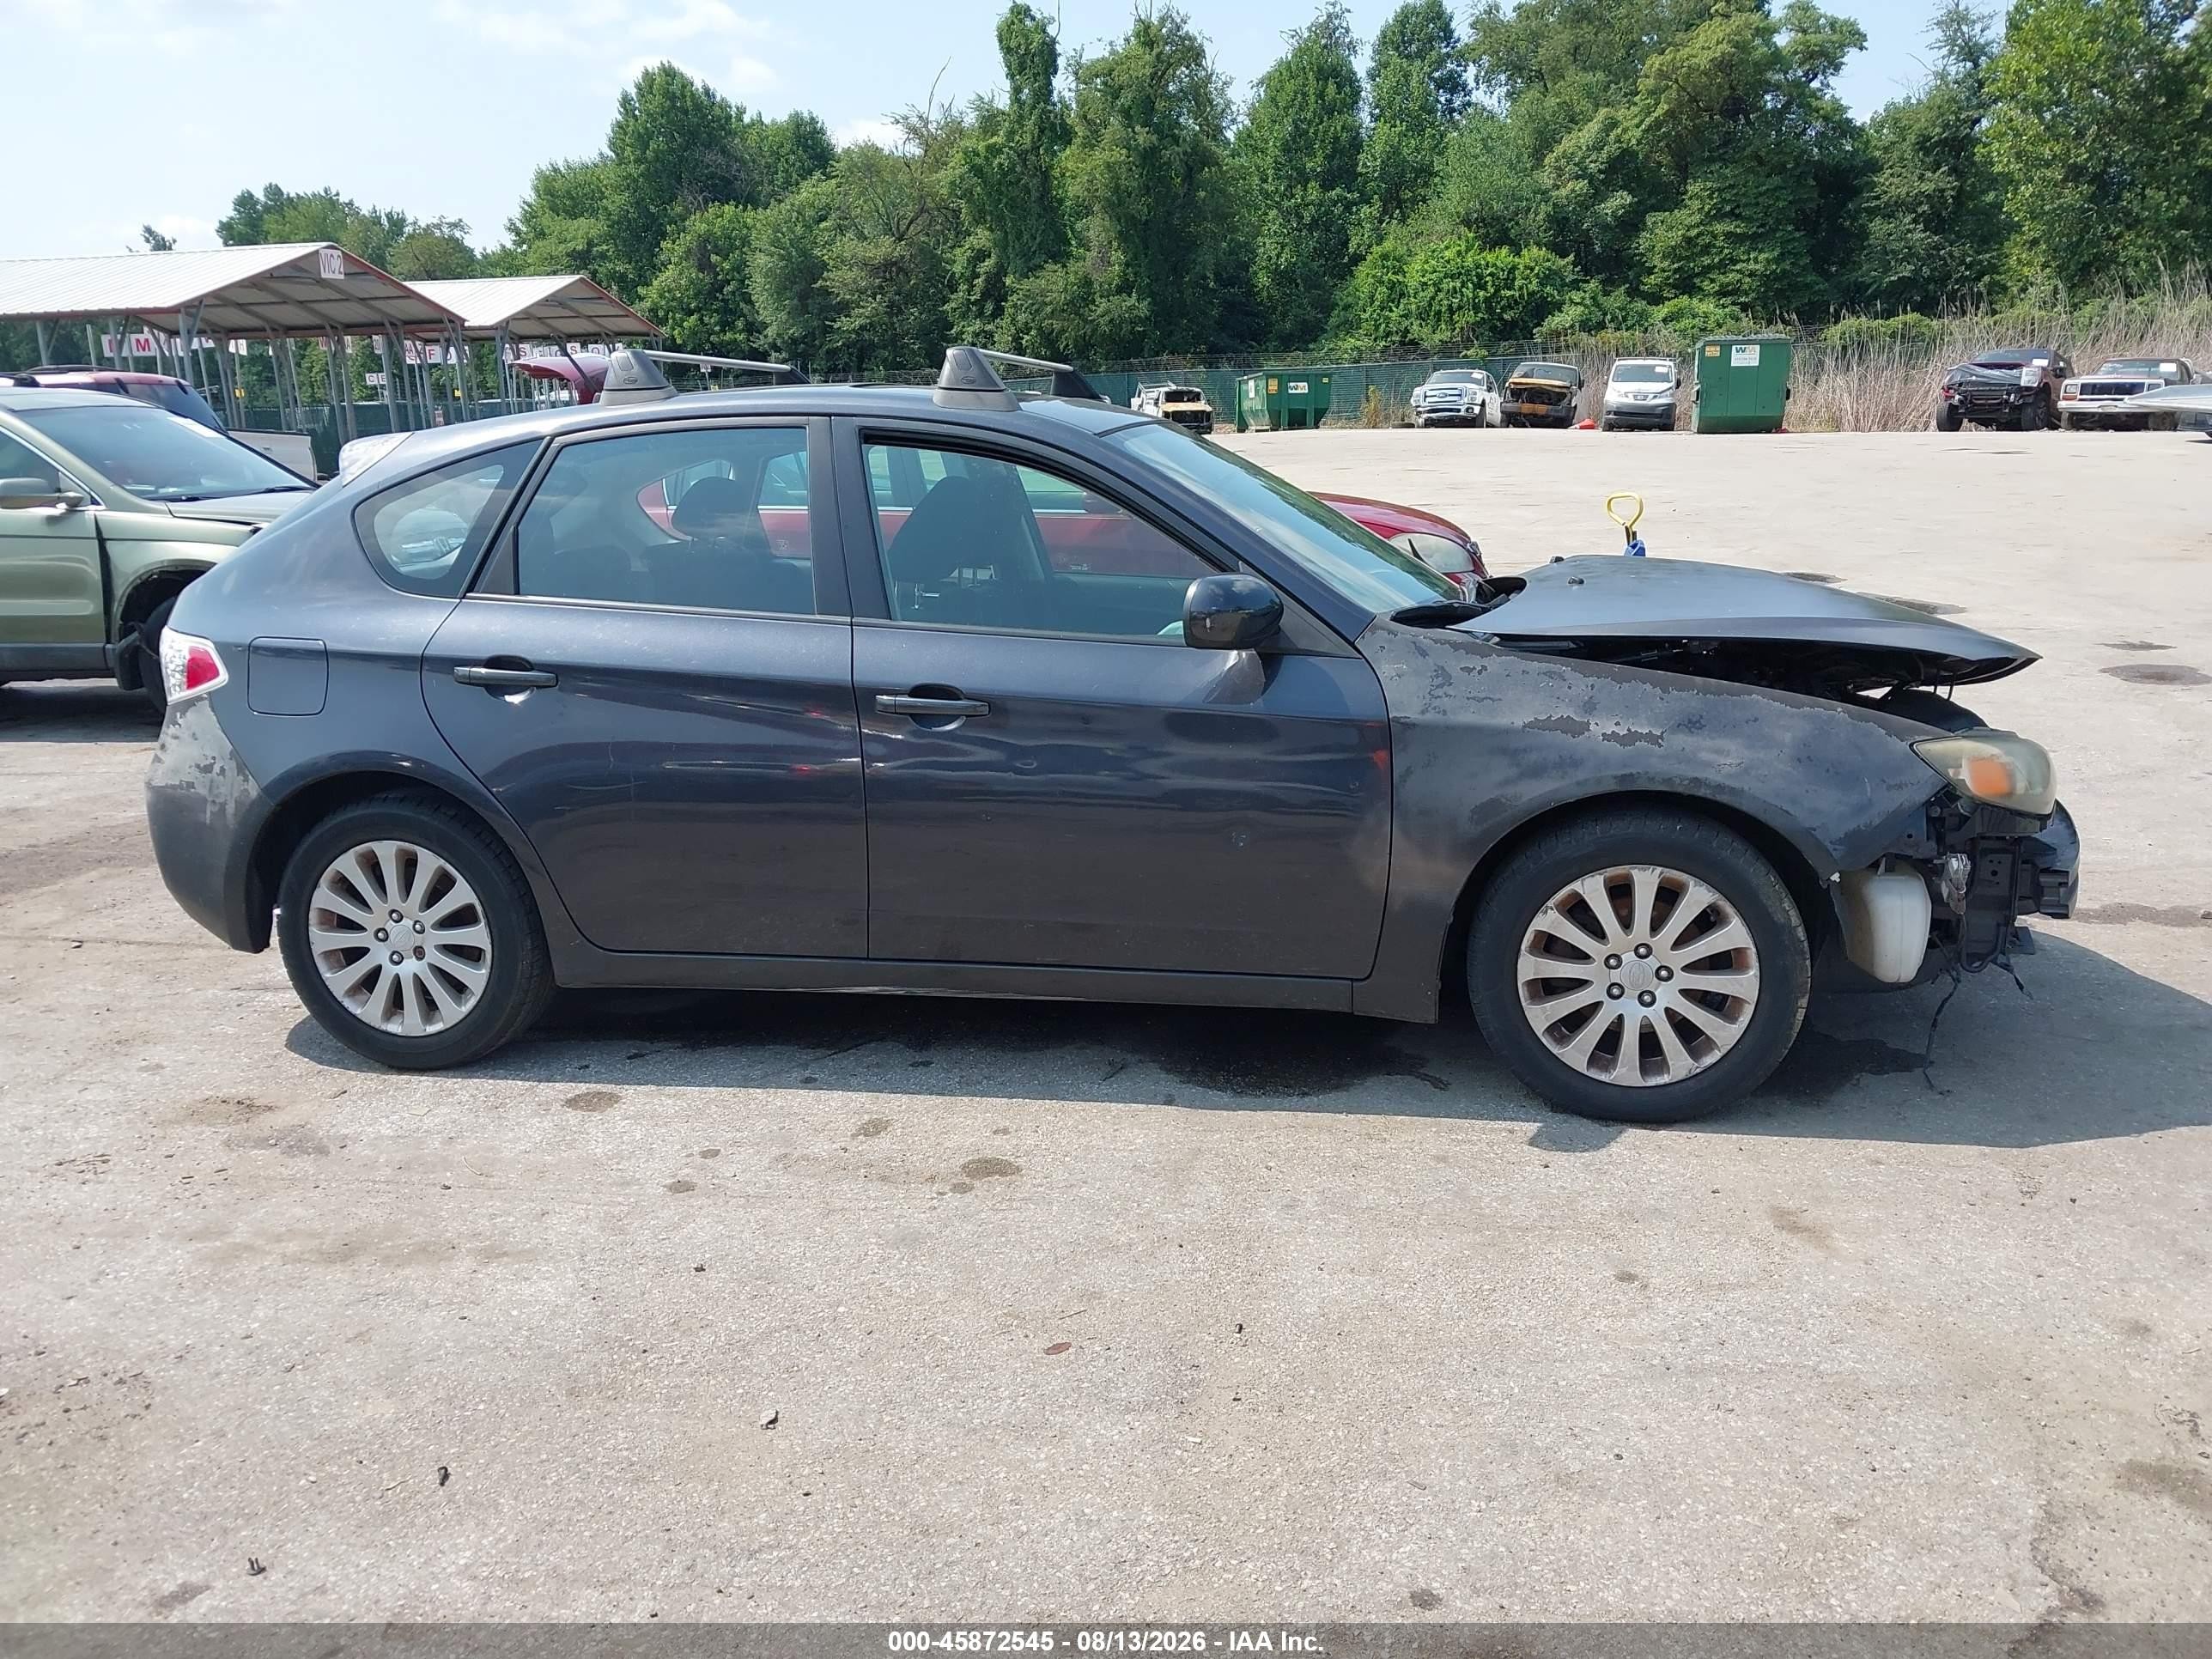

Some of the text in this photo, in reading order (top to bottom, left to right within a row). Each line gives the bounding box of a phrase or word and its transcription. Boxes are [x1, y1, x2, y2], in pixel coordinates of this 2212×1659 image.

[319, 253, 343, 275] VIC 2
[135, 337, 151, 352] M
[570, 345, 578, 355] S
[428, 349, 435, 360] F
[520, 347, 526, 356] S
